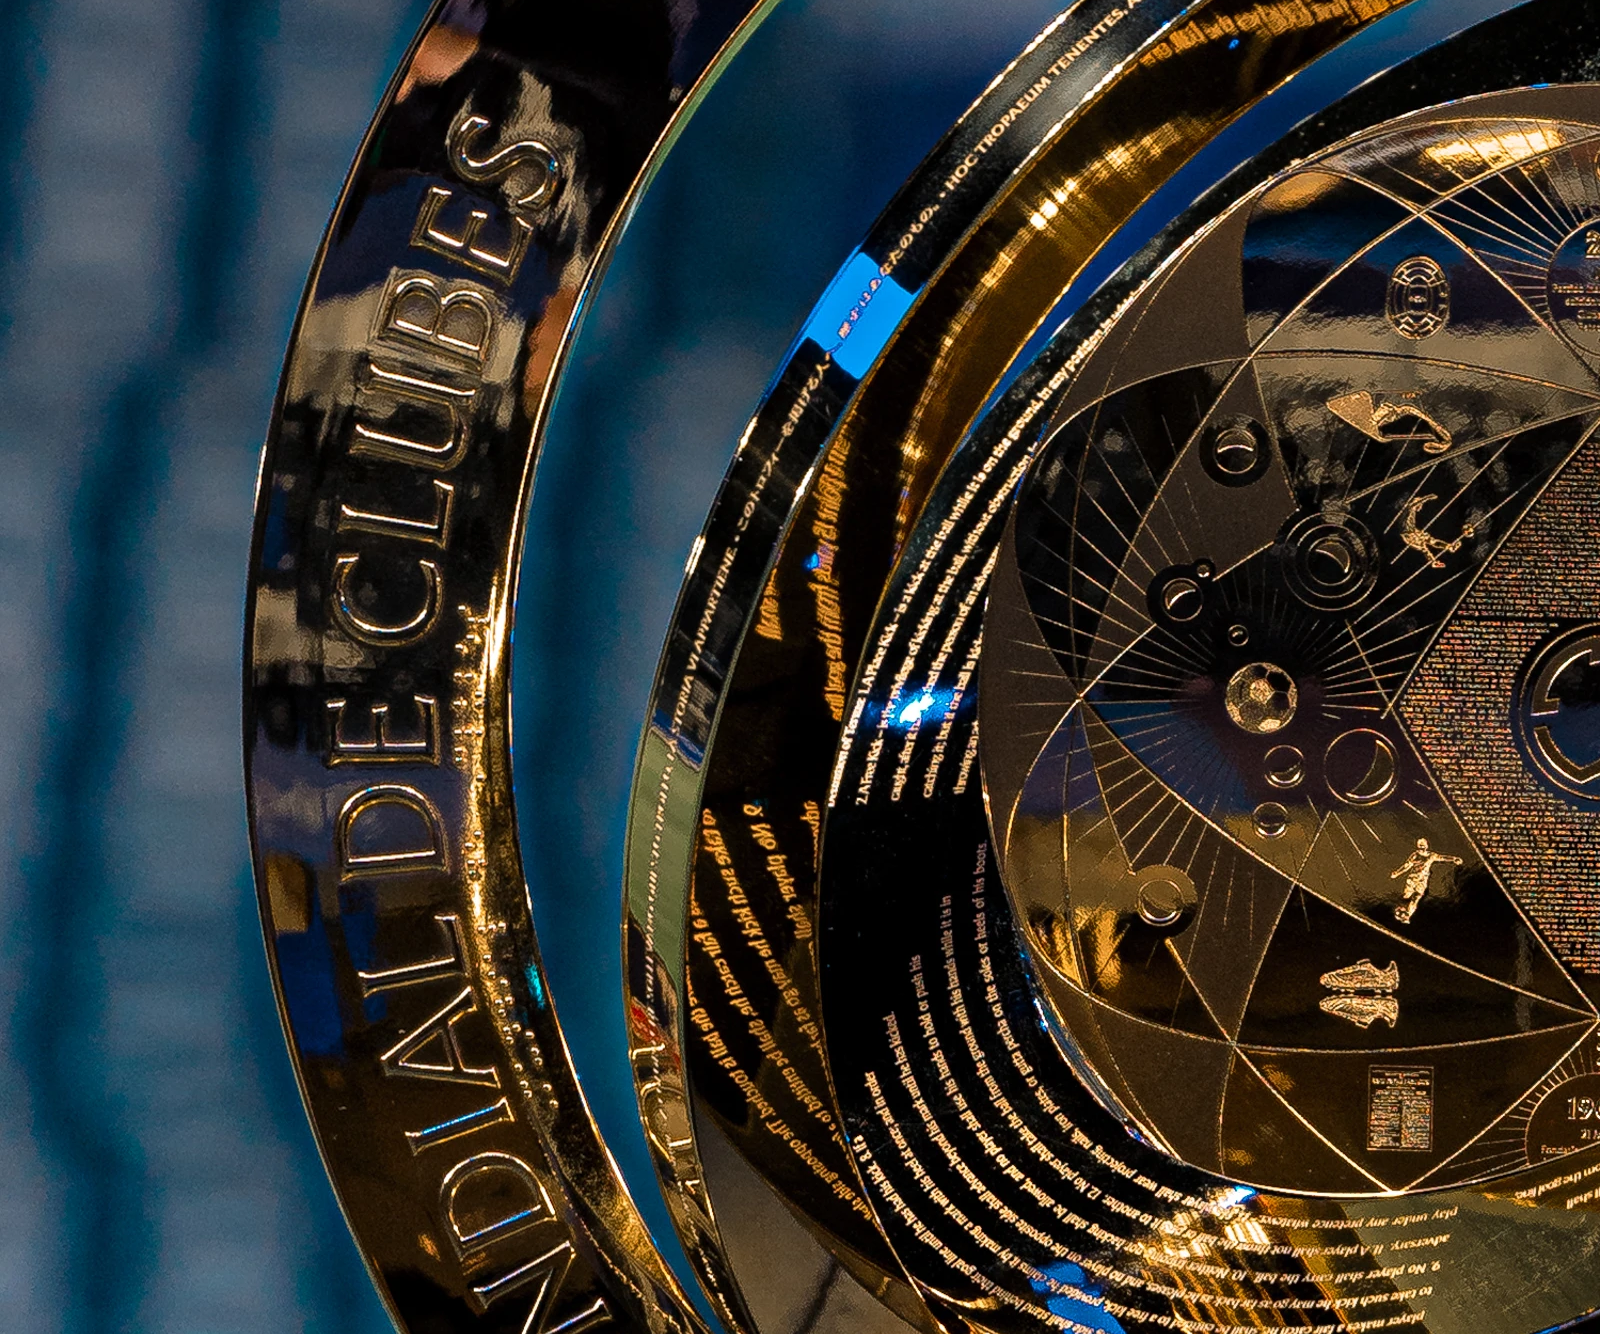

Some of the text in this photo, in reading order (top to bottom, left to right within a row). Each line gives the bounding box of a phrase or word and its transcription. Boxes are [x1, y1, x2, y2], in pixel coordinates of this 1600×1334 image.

[943, 149, 979, 191] HOC
[974, 75, 1052, 153] TROPAEUM
[1046, 7, 1129, 79] TENENTES,
[330, 114, 563, 647] CLUBES
[1047, 366, 1070, 390] any
[1035, 386, 1053, 401] in
[1006, 398, 1044, 441] ground,
[991, 436, 1012, 458] the
[981, 455, 999, 473] on
[965, 480, 980, 493] it
[971, 471, 987, 483] is
[948, 490, 974, 520] while
[933, 518, 955, 541] ball
[924, 538, 943, 560] the
[918, 558, 932, 574] at
[902, 571, 925, 595] kick
[901, 593, 913, 603] a
[892, 602, 908, 614] is
[877, 622, 899, 647] Kick
[685, 651, 700, 670] VI
[864, 646, 887, 677] Place
[325, 695, 448, 882] DE
[908, 953, 922, 972] his
[910, 971, 929, 998] push
[917, 999, 929, 1012] or
[917, 1011, 936, 1038] hold
[927, 1036, 940, 1050] to
[929, 1048, 951, 1081] hands
[943, 1077, 959, 1096] his
[951, 1092, 968, 1111] use
[958, 1108, 982, 1131] shall
[974, 1129, 1003, 1156] player
[994, 1153, 1010, 1168] no
[1001, 1163, 1025, 1182] and
[1018, 1176, 1055, 1208] allowed,
[1052, 1203, 1068, 1219] be
[1061, 1211, 1089, 1230] shall
[1086, 1222, 1127, 1252] hacking
[1334, 1271, 1364, 1284] shall
[1364, 1263, 1405, 1282] player
[1406, 1262, 1427, 1275] No
[1278, 1272, 1301, 1285] the
